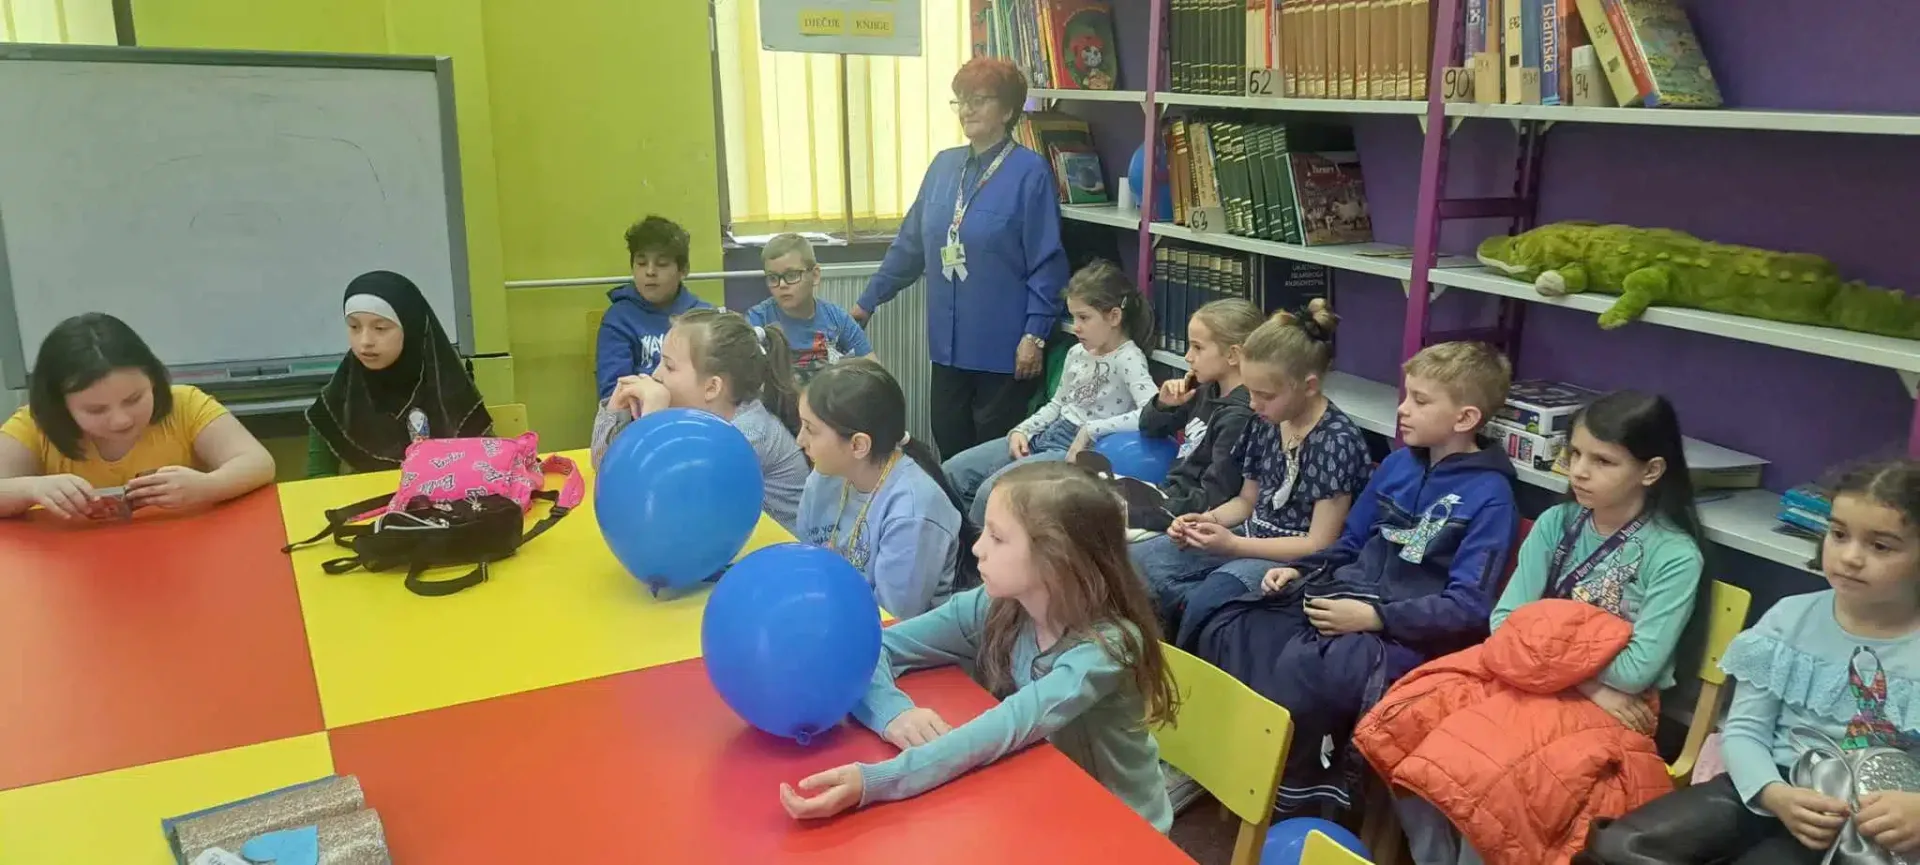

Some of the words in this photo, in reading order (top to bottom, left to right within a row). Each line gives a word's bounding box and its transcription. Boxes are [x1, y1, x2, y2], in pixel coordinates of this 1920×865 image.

[855, 20, 890, 31] KNJIGE
[1543, 3, 1556, 73] Islamska
[1250, 70, 1273, 95] 62
[1444, 68, 1470, 99] 90
[1575, 73, 1589, 98] 94
[1191, 210, 1208, 231] 63
[1620, 521, 1642, 537] burn
[1576, 562, 1593, 577] burn
